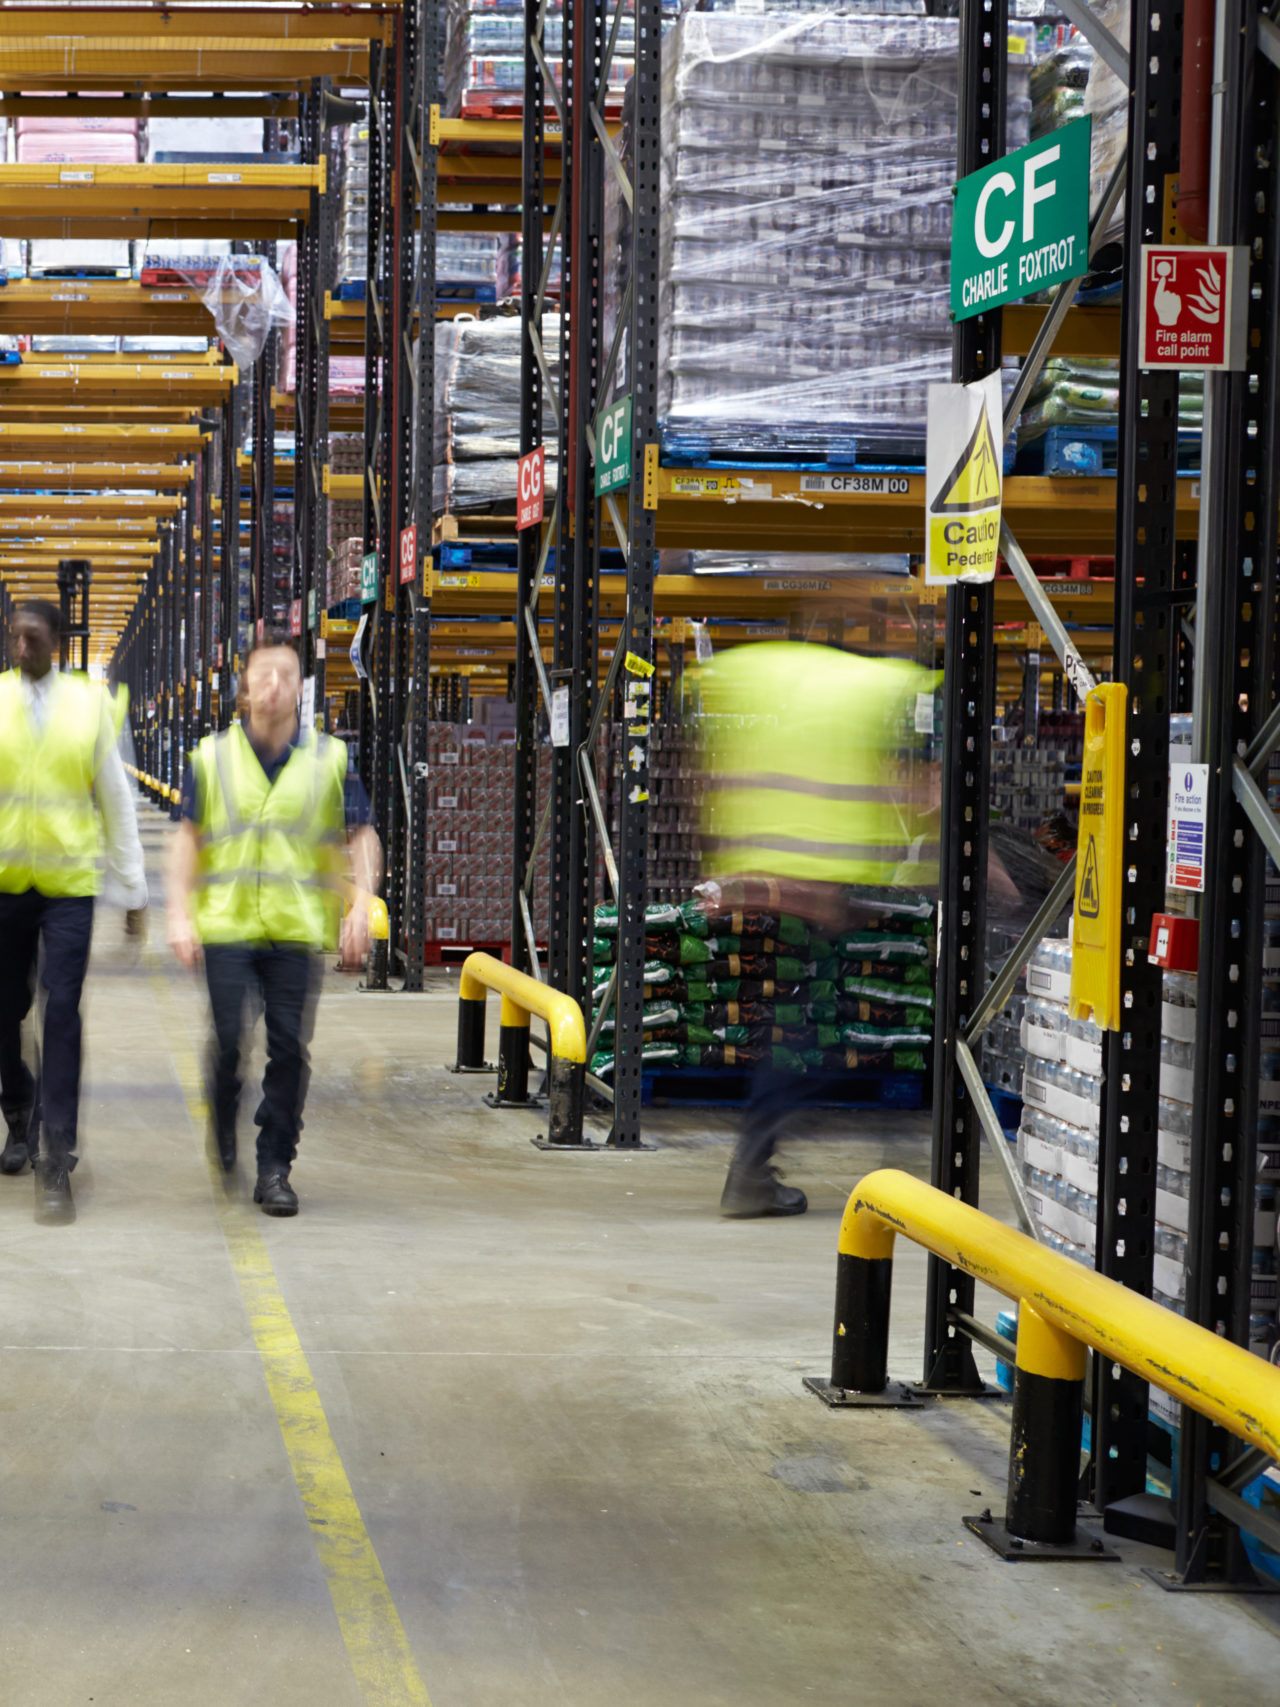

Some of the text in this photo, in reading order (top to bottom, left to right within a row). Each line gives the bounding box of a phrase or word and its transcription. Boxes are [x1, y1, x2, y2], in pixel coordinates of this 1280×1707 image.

[974, 143, 1061, 259] CF
[962, 235, 1076, 308] CHARLIE FOXTROT
[1155, 329, 1212, 343] Fire alarm
[1157, 344, 1210, 359] call point
[601, 406, 625, 464] CF
[521, 453, 540, 502] CG
[831, 477, 909, 493] CF38M 00
[401, 531, 414, 566] CG
[363, 556, 375, 587] CH
